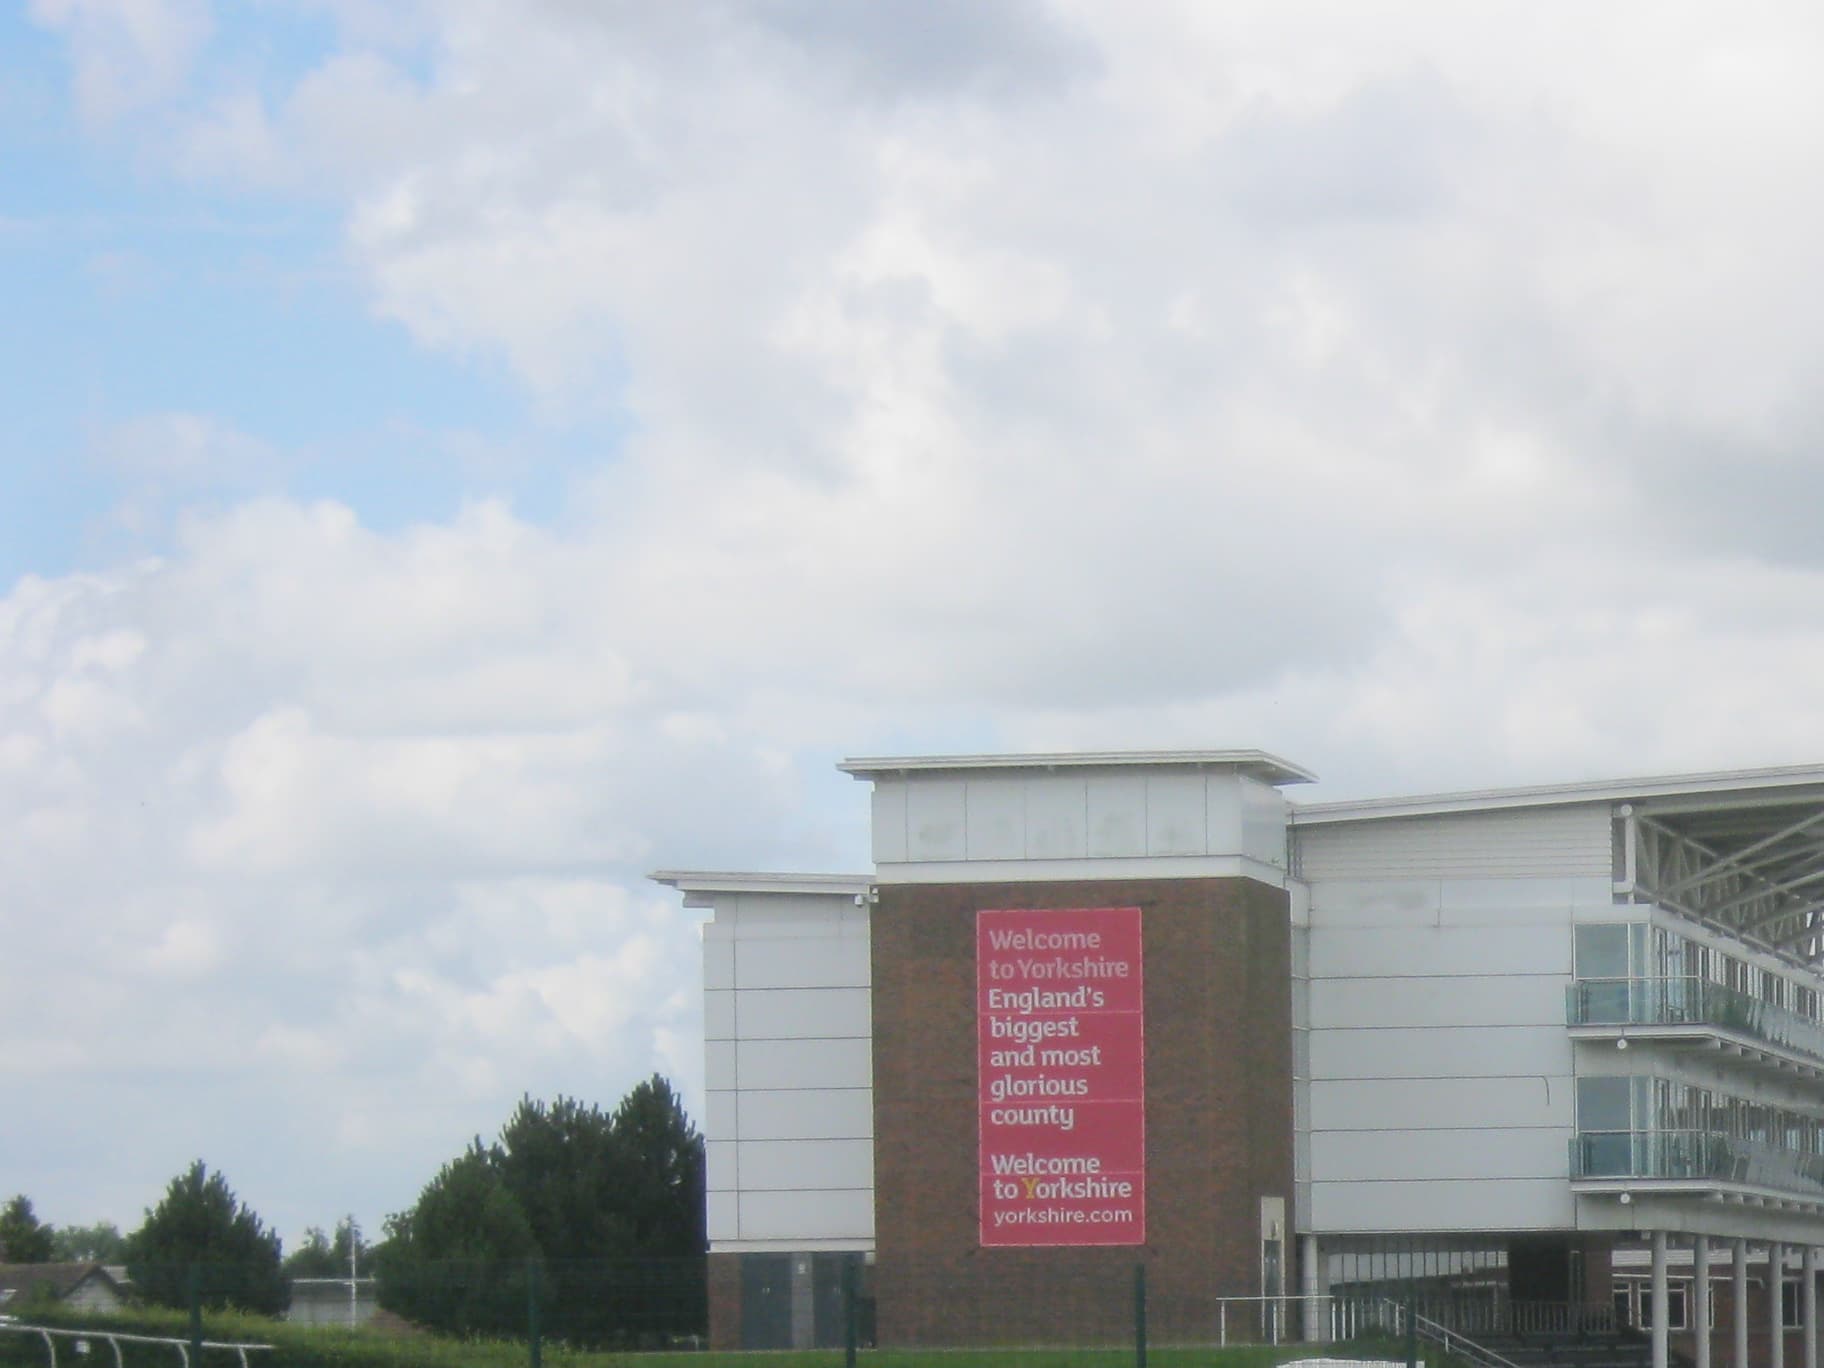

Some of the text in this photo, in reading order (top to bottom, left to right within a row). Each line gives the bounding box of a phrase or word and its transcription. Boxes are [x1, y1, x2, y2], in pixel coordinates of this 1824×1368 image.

[989, 929, 1101, 950] Welcome
[990, 957, 1129, 980] to Yorkshire
[988, 986, 1105, 1014] England's
[990, 1016, 1079, 1043] biggest
[990, 1045, 1101, 1067] and most
[990, 1074, 1088, 1102] glorious
[990, 1104, 1075, 1130] county
[991, 1153, 1101, 1175] Welcome
[993, 1177, 1132, 1200] to Yorkshire
[994, 1206, 1133, 1227] yorkshire.com
